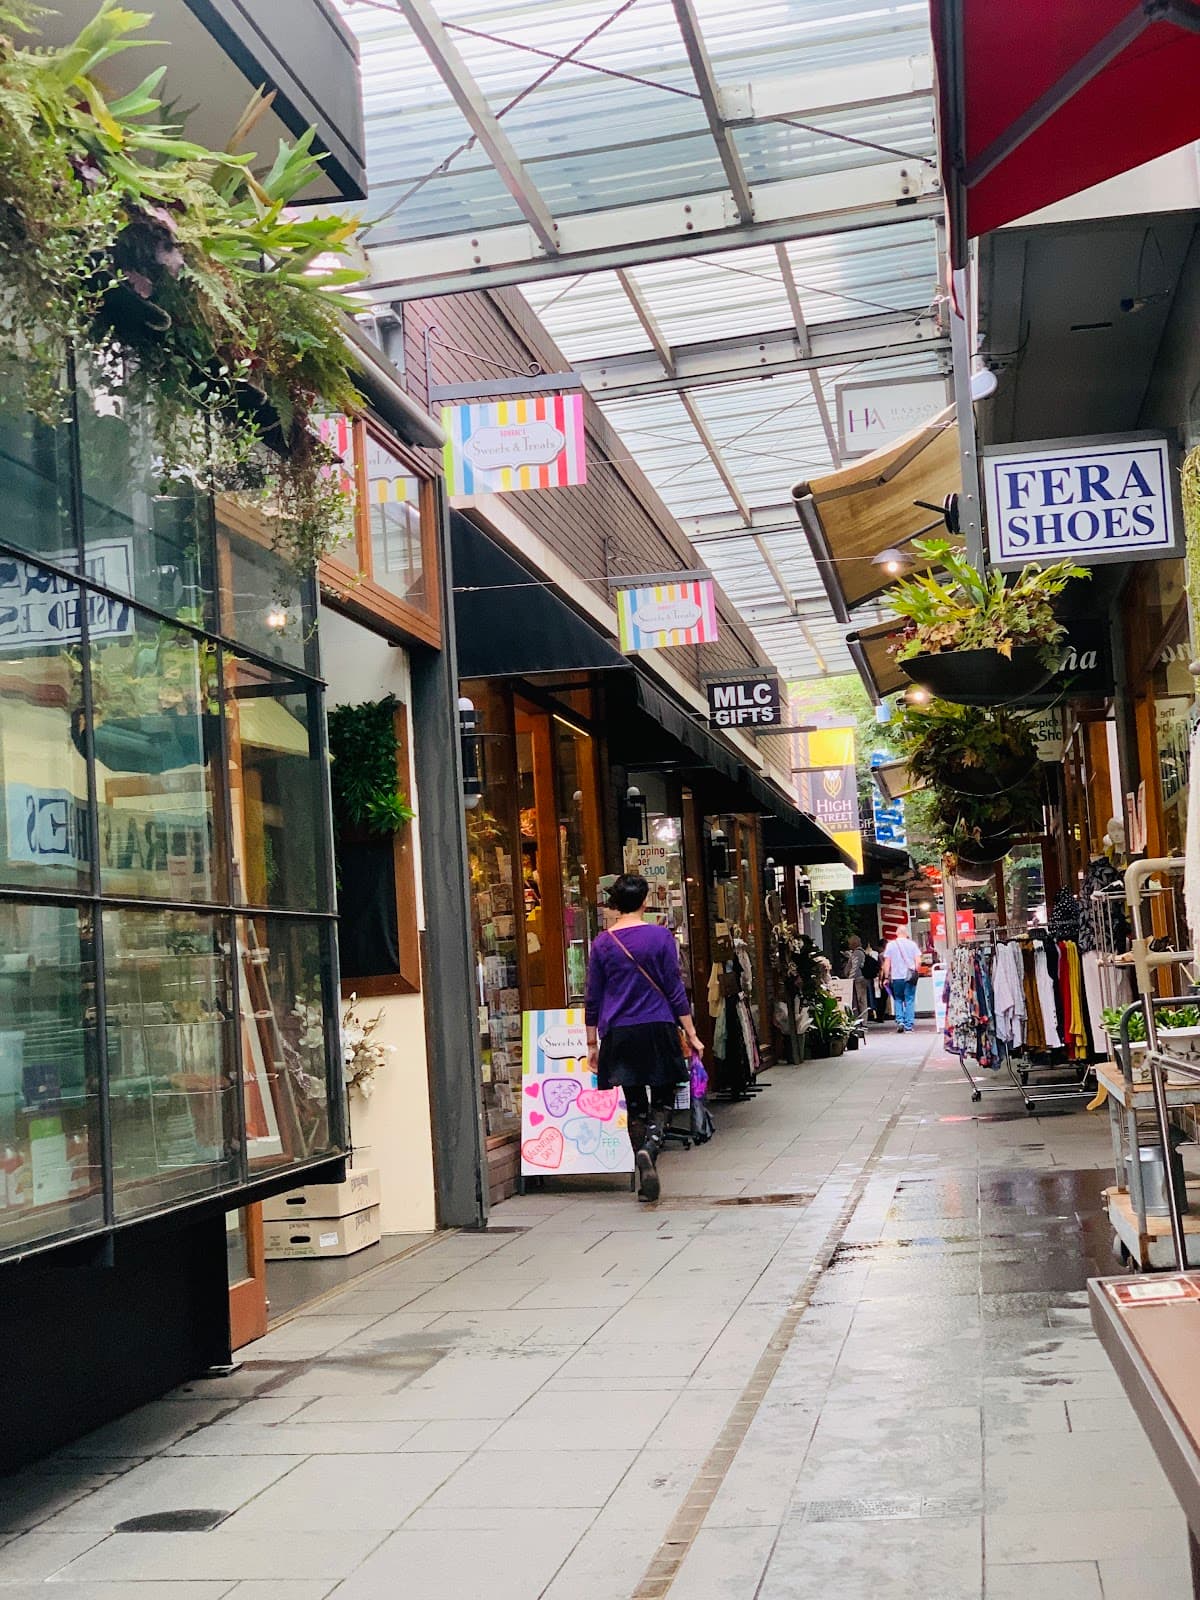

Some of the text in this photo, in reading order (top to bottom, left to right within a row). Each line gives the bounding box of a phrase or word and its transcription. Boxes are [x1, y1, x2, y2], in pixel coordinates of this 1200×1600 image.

[472, 436, 556, 455] Sweets & Treats
[1003, 460, 1156, 510] FERA
[1008, 504, 1156, 547] SHOES
[713, 683, 772, 708] MLC
[715, 706, 774, 726] GIFTS
[816, 799, 852, 813] HIGH
[545, 1036, 584, 1048] Sweets &
